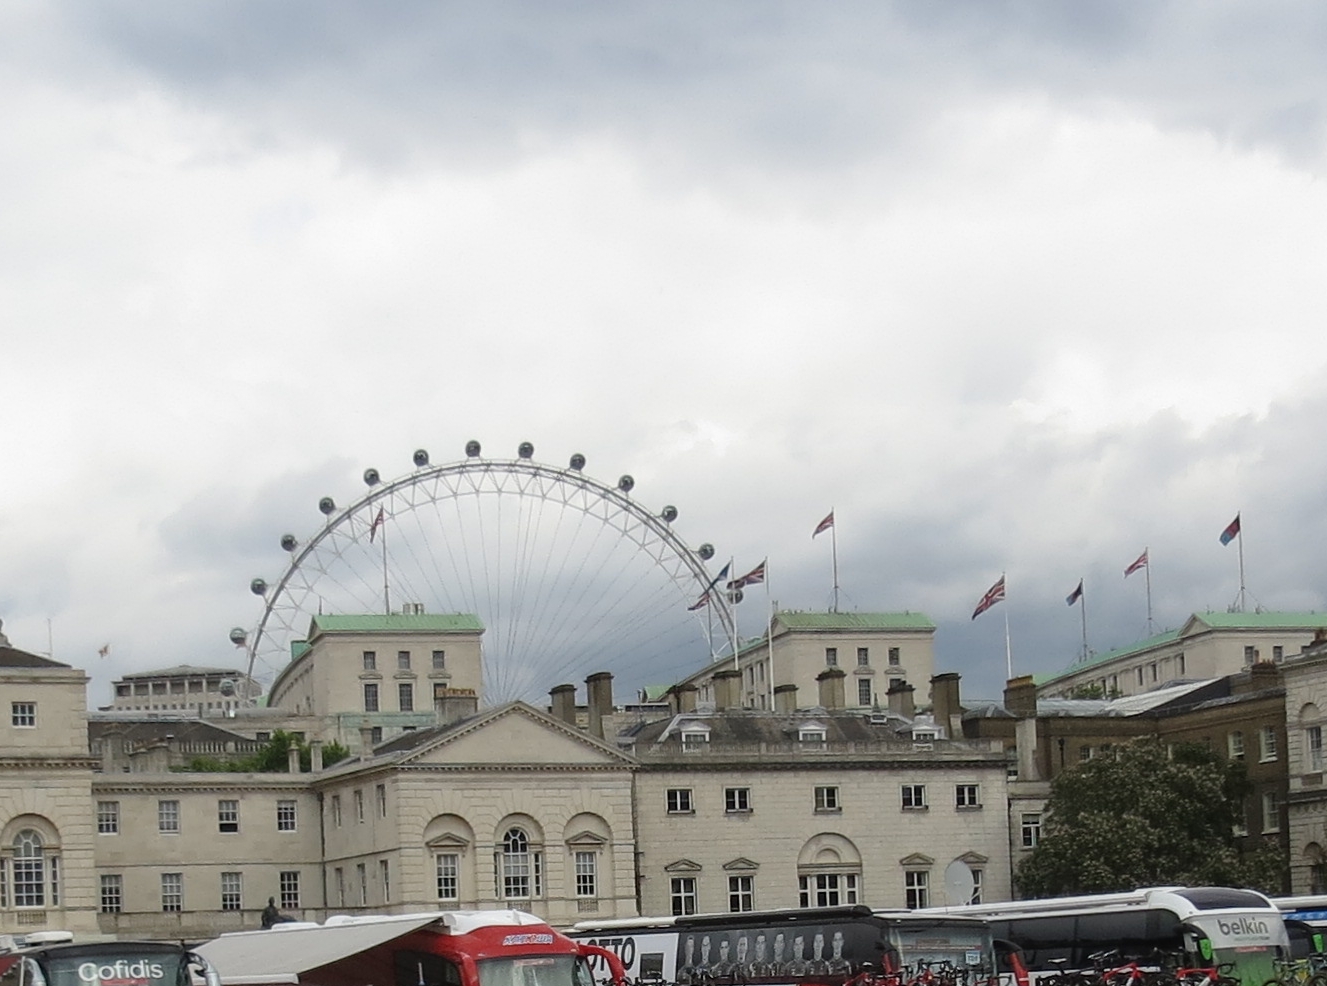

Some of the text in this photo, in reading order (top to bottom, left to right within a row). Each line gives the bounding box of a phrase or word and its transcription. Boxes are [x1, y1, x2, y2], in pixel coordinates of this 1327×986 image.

[1217, 917, 1269, 936] belkin
[577, 937, 636, 972] OTTO
[78, 959, 164, 982] Cofidis
